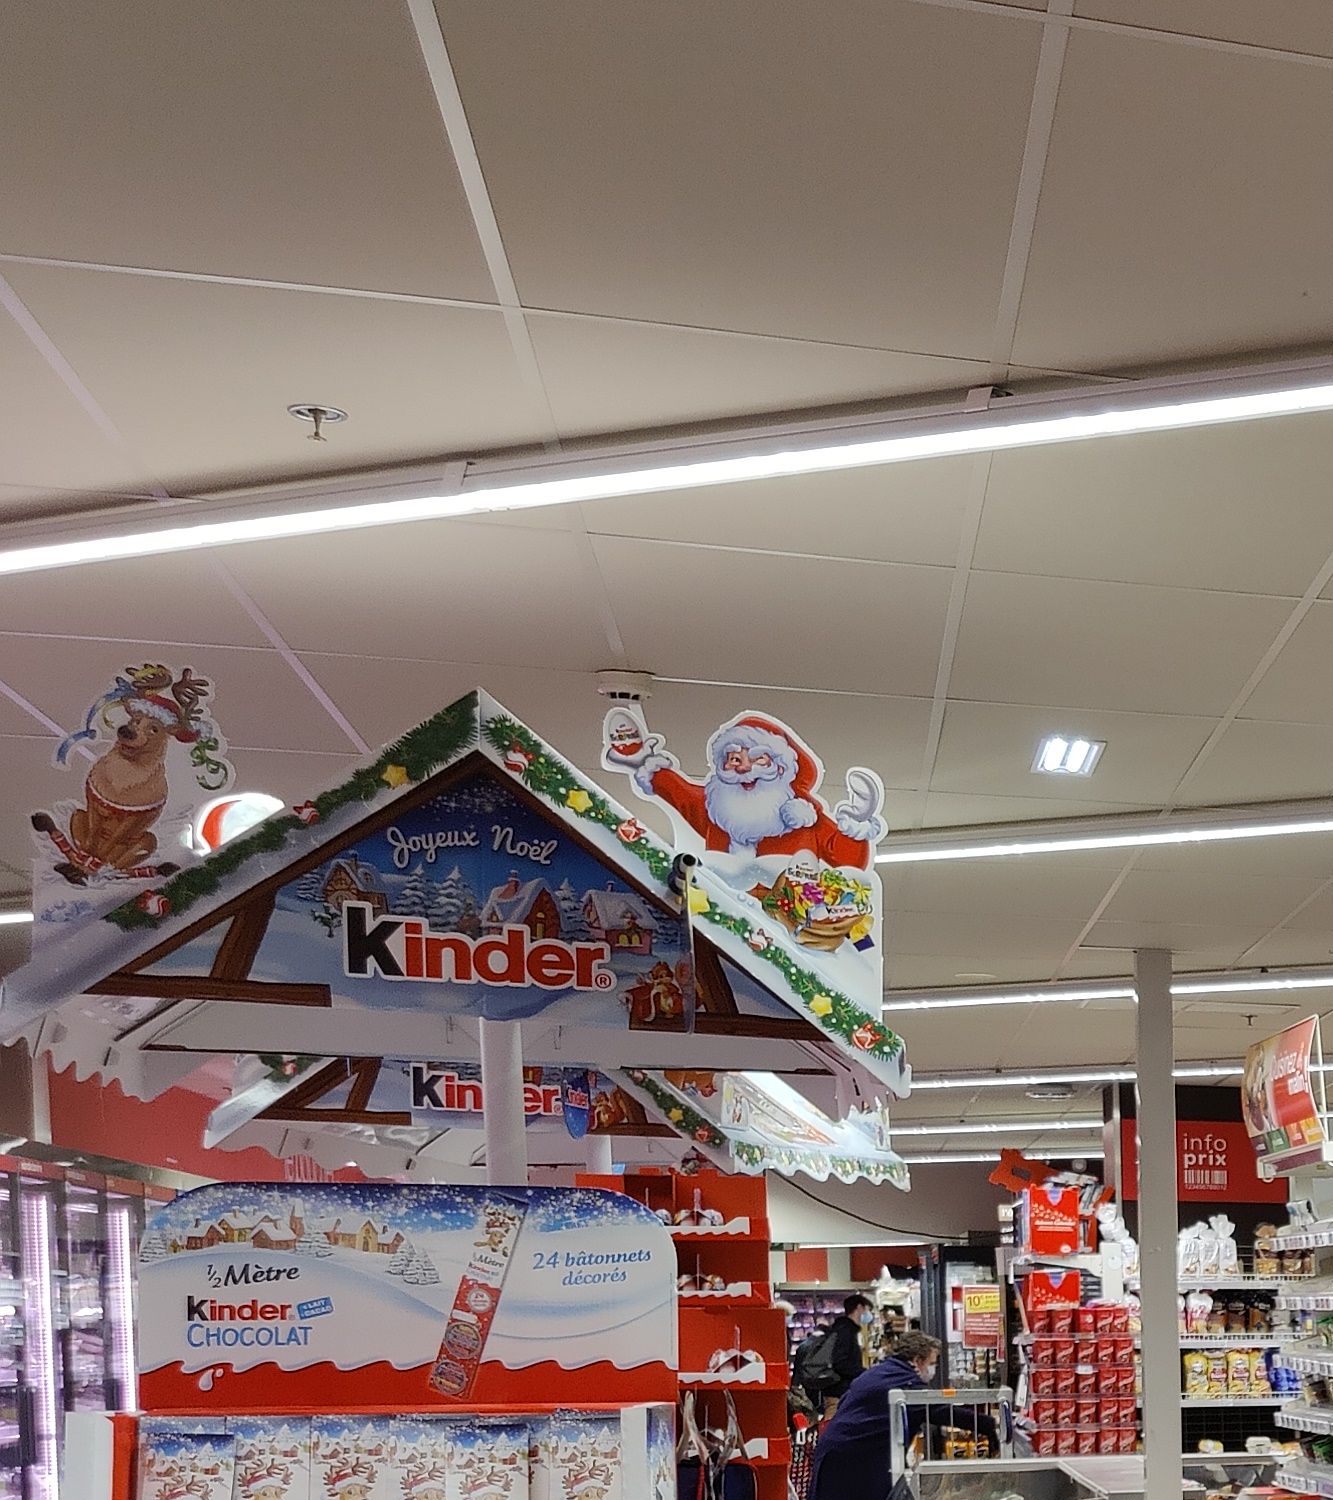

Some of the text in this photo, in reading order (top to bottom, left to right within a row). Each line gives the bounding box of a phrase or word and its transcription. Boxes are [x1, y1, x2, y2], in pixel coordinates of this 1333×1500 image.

[385, 823, 558, 867] Joyeux Noël
[1184, 1133, 1227, 1151] info
[1184, 1151, 1227, 1169] prix
[532, 1249, 652, 1271] 24 bâtonnets
[224, 1263, 301, 1287] Mètre
[562, 1269, 629, 1287] décorés
[187, 1323, 313, 1348] CHOCOLAT
